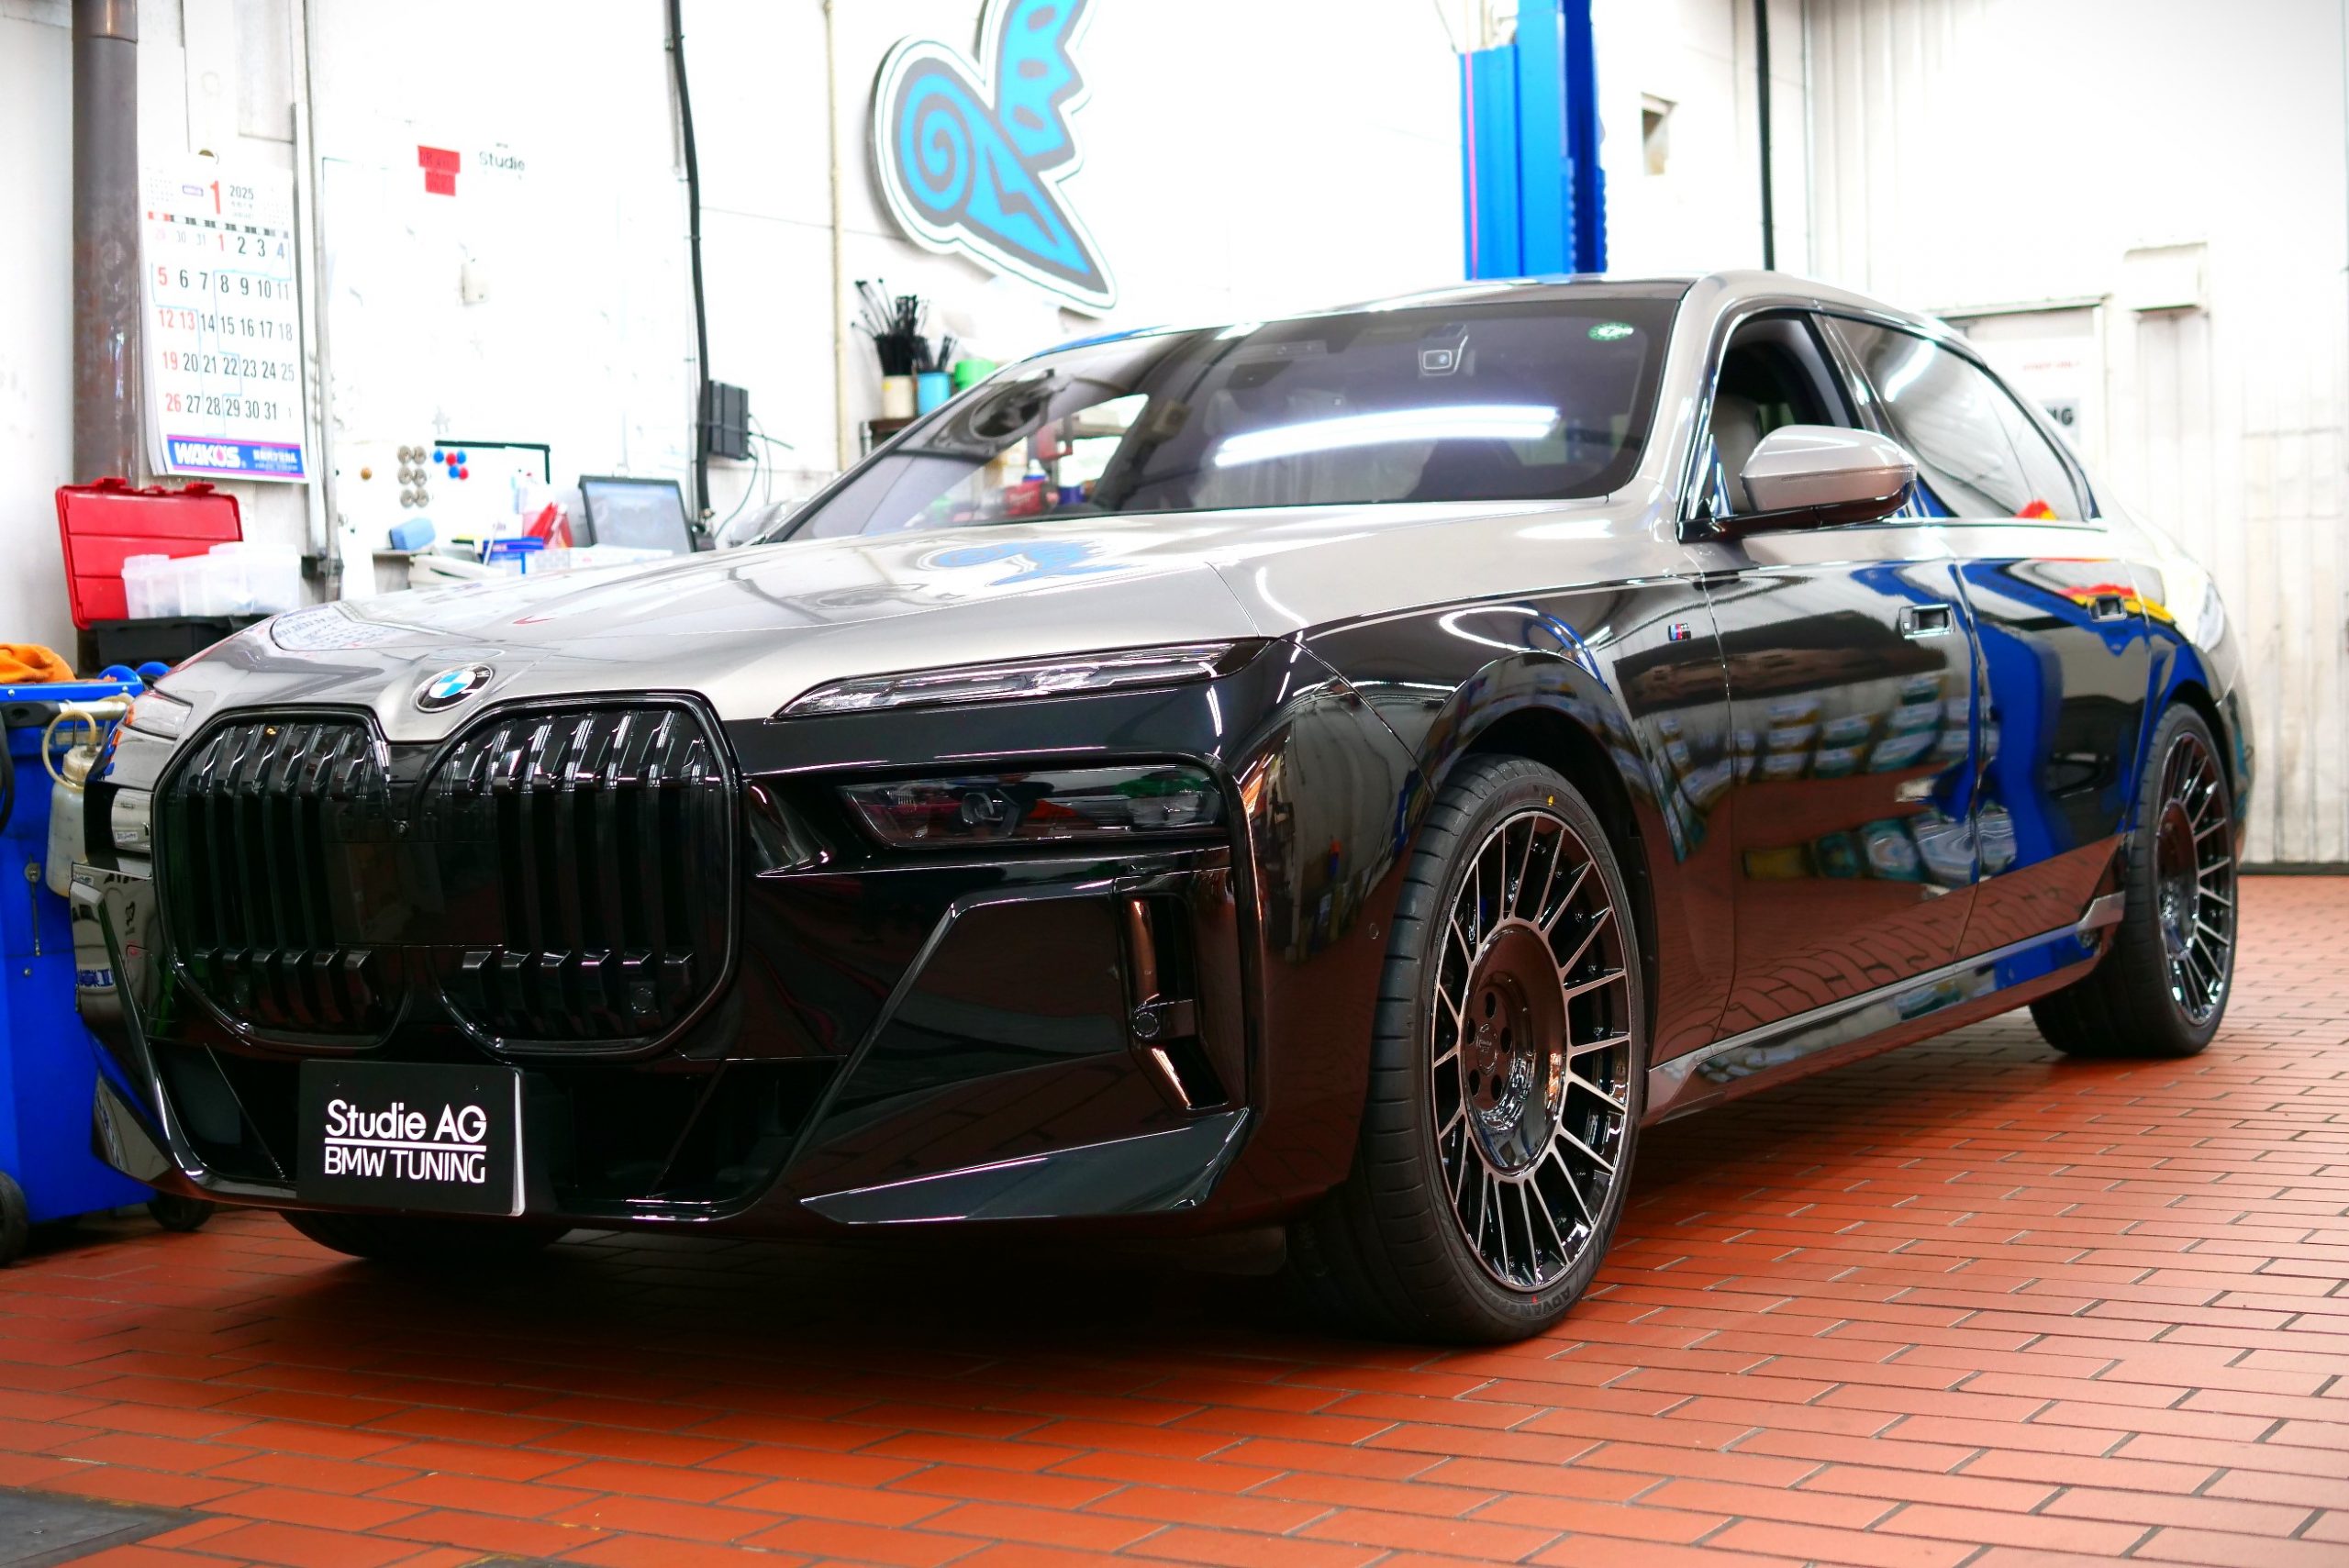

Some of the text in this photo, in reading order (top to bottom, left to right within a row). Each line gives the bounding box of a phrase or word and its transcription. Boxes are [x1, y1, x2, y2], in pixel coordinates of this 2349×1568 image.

[479, 151, 525, 172] Studie
[210, 180, 221, 215] 1
[229, 184, 254, 200] 2025
[177, 230, 186, 243] 30
[196, 233, 206, 246] 31
[218, 233, 224, 251] 1
[238, 236, 246, 255] 2
[257, 239, 266, 257] 3
[277, 241, 285, 259] 4
[158, 266, 289, 300] 5 6 7 8 9 10 11
[159, 308, 293, 341] 12 13 14 15 16 17 18
[162, 350, 295, 382] 19 20 21 22 23 24 25
[165, 393, 182, 412] 26
[186, 395, 201, 414] 27
[206, 396, 221, 416] 28
[226, 398, 240, 417] 29
[245, 400, 260, 418] 30
[264, 402, 277, 420] 31
[325, 1099, 487, 1143] Studie AG
[325, 1146, 485, 1184] BMW TUNING
[1520, 1285, 1572, 1317] ADVAN
